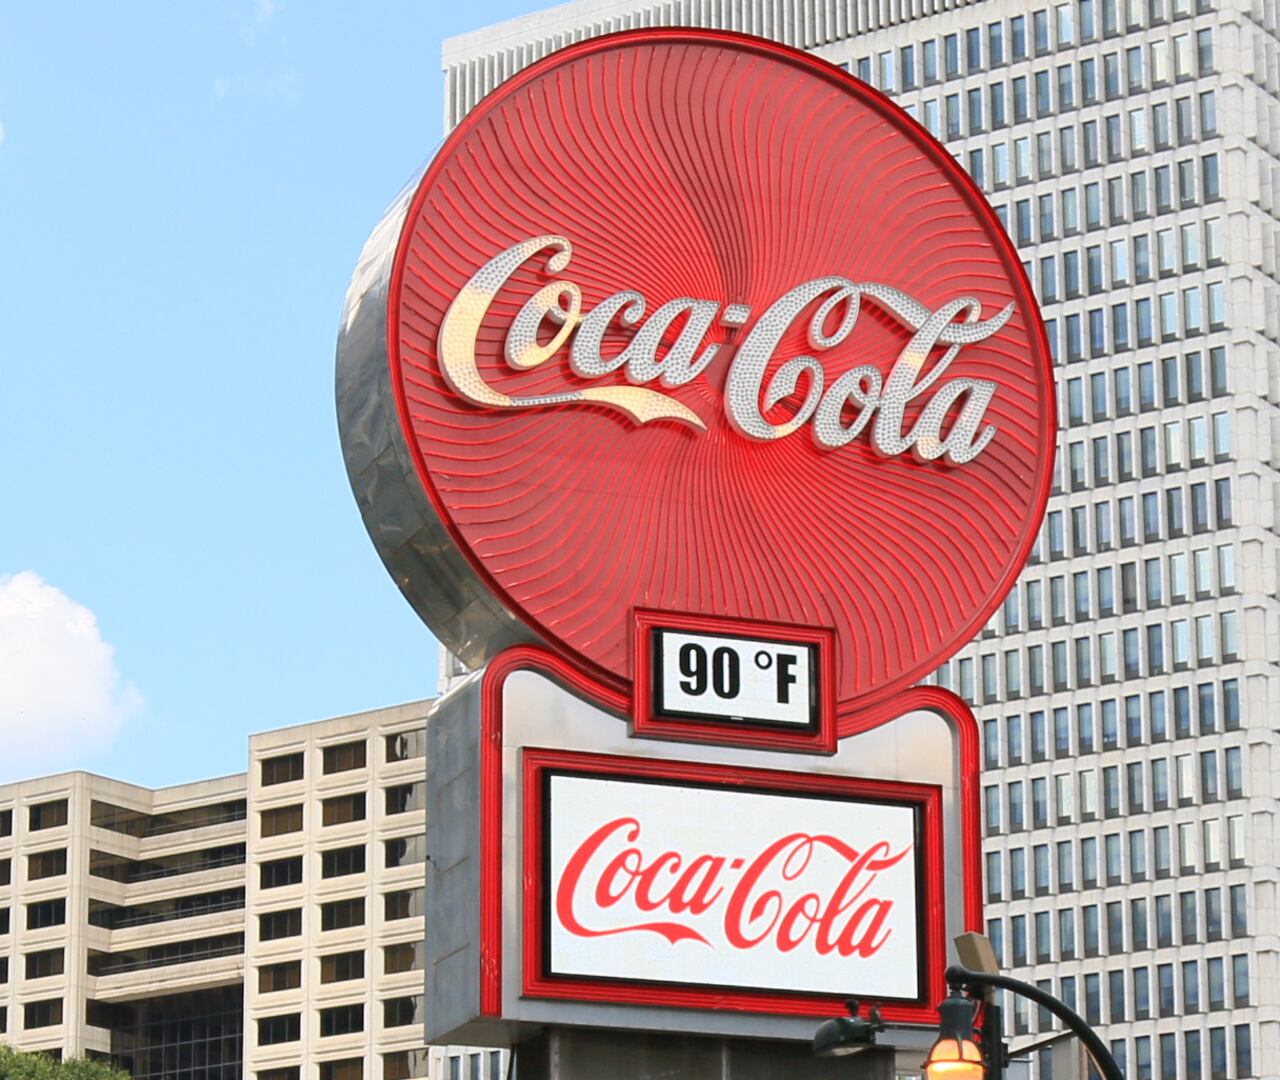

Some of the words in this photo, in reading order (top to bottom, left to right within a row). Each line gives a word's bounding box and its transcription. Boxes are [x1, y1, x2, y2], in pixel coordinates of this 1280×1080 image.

[437, 234, 1015, 465] Coca-Cola
[678, 642, 740, 700] 90
[555, 816, 914, 959] Coca-Cola
